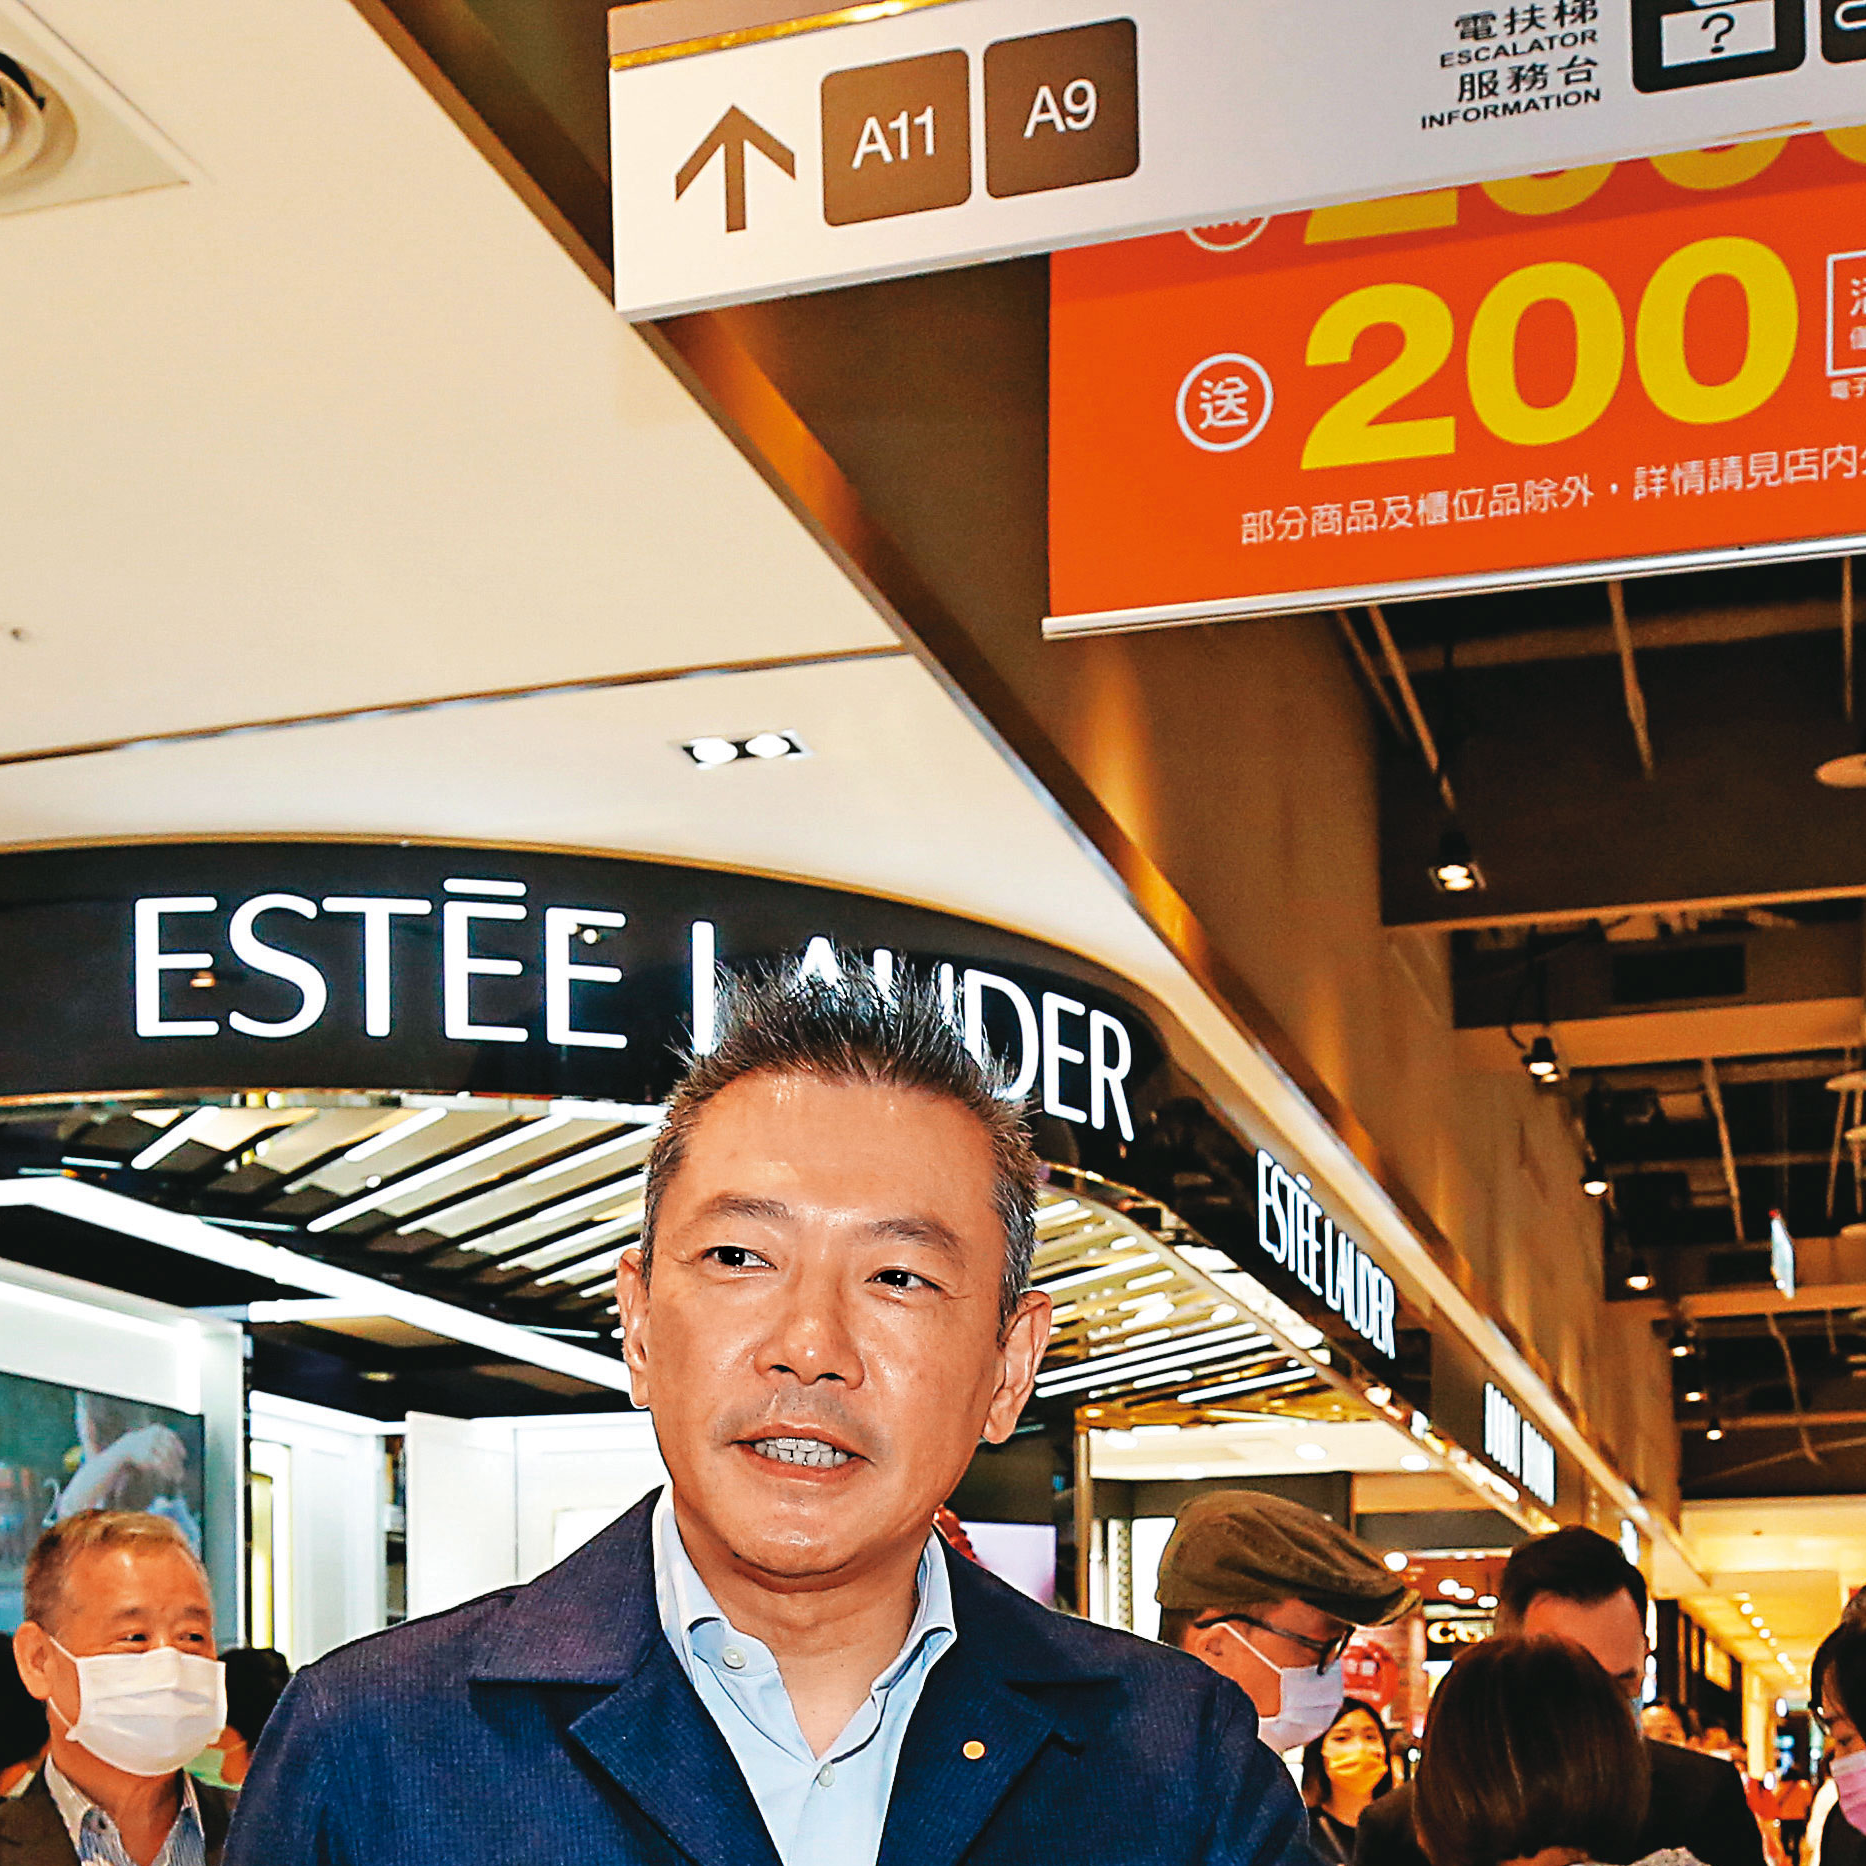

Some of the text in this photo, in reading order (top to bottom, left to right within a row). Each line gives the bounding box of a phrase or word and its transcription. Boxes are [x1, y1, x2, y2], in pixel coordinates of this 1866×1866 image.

[1455, 0, 1598, 40] 電扶梯
[1440, 29, 1598, 68] ESCALATOR
[1458, 54, 1598, 103] 服務台
[852, 78, 1098, 170] A11 A9
[1421, 88, 1600, 129] INFORMATION
[1300, 235, 1800, 470] 200
[1324, 1217, 1397, 1360] LAUDER
